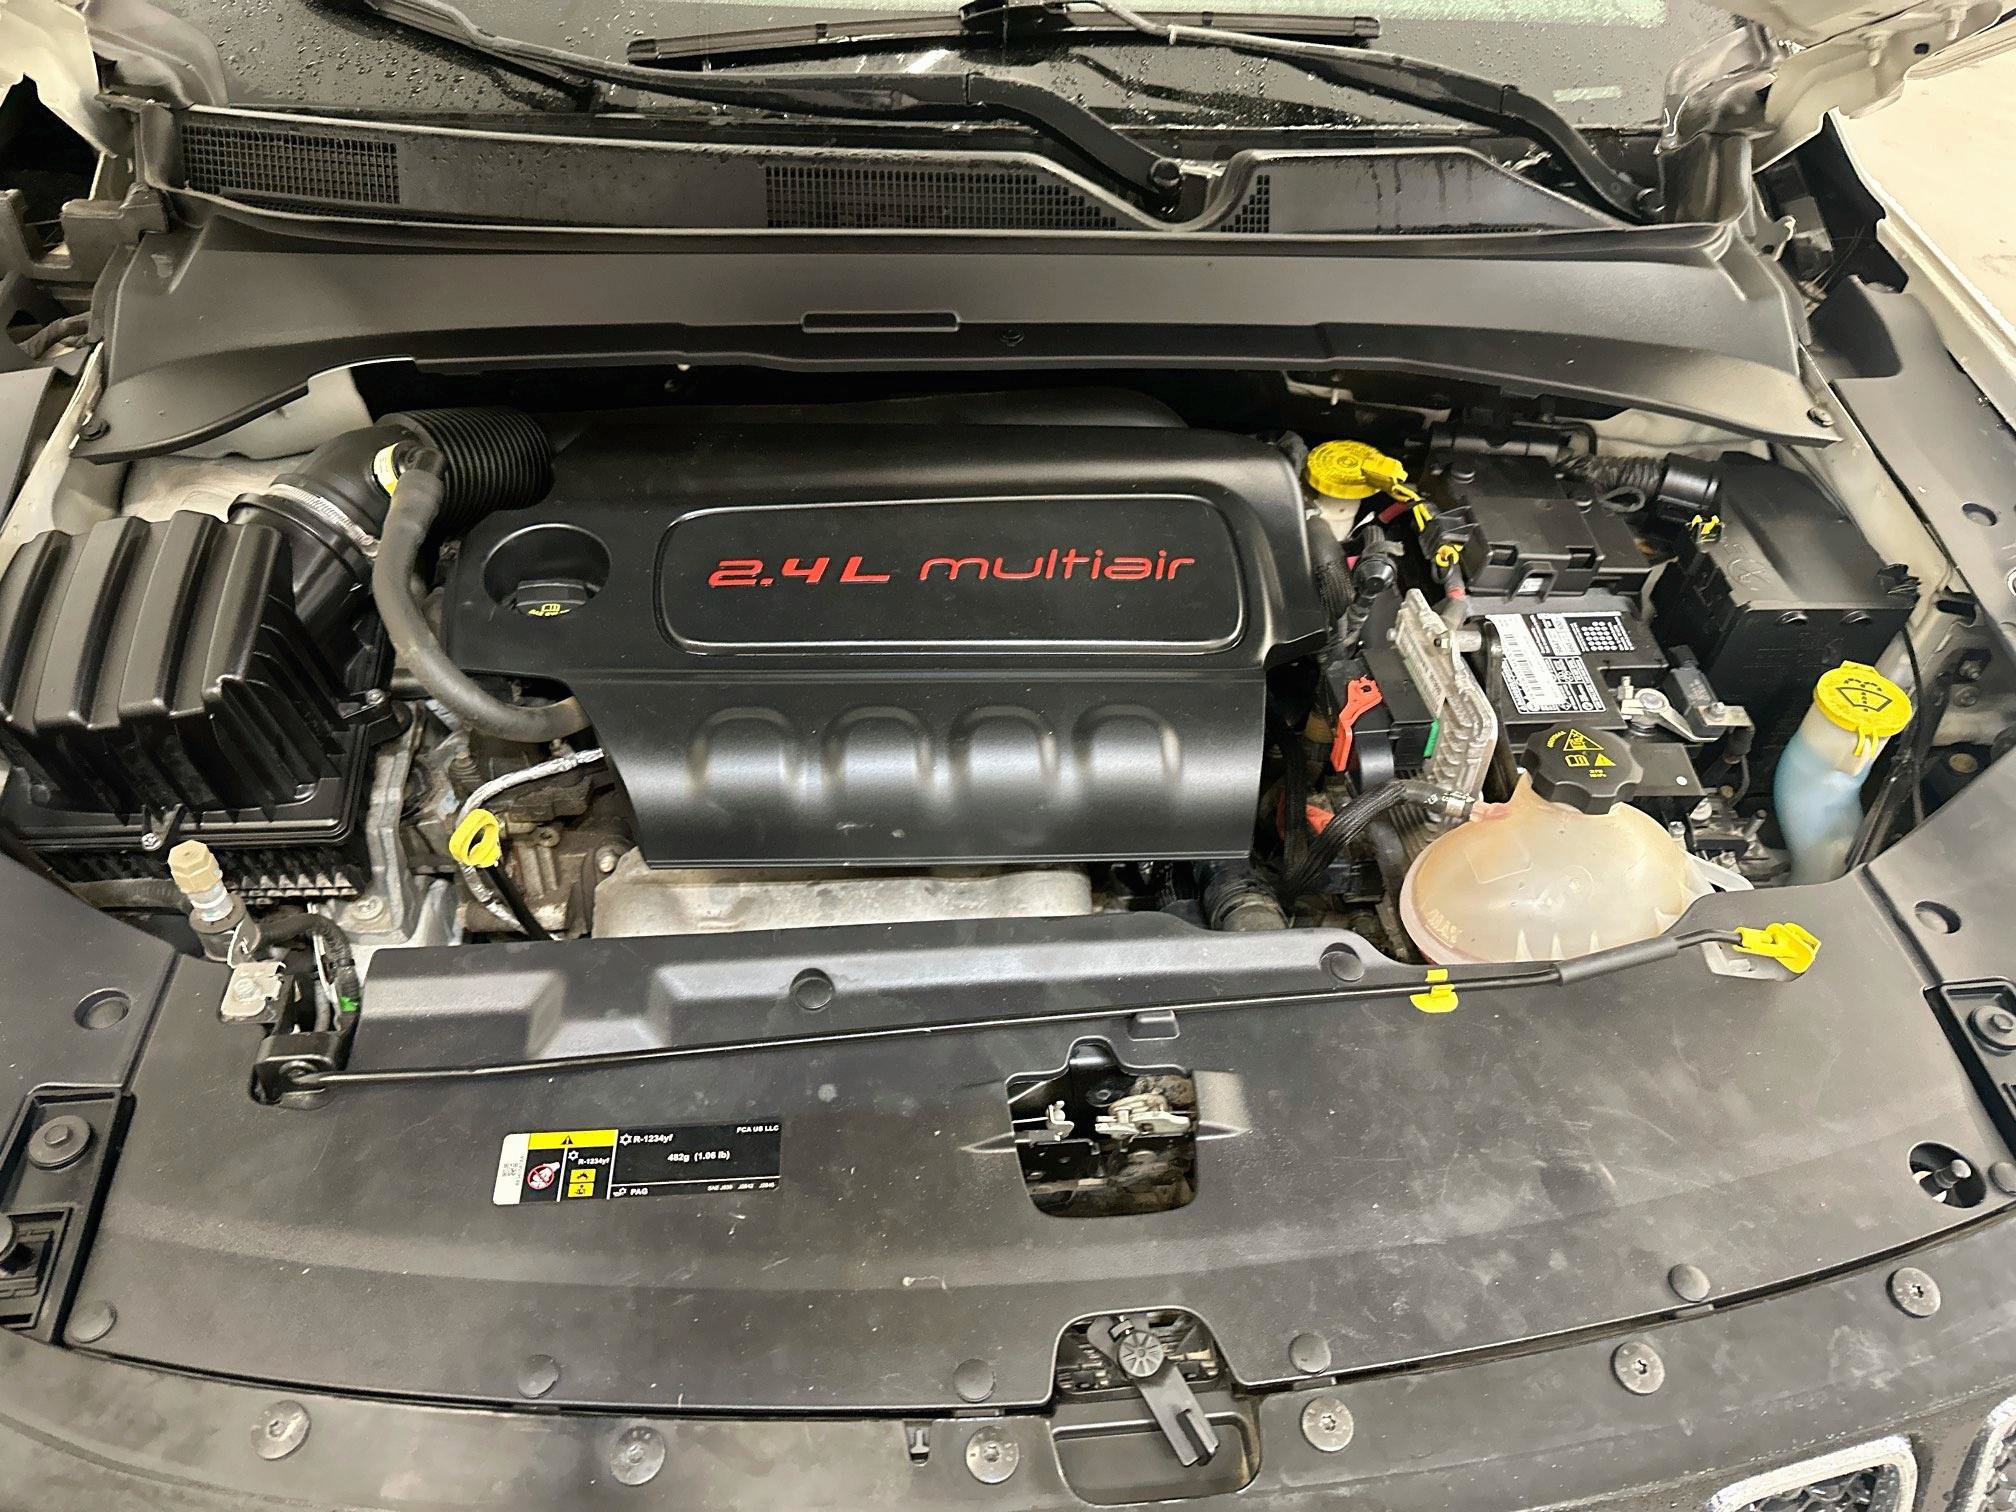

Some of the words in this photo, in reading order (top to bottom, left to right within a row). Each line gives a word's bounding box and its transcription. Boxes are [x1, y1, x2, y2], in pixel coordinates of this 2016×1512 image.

[918, 548, 1196, 581] multiair
[736, 1126, 752, 1134] FCA
[765, 1124, 780, 1132] LLC
[633, 1133, 674, 1144] R-1234yf
[577, 1157, 611, 1165] R-1234yf
[667, 1152, 690, 1163] 482g
[717, 1150, 731, 1160] lb)
[630, 1187, 649, 1196] PAG
